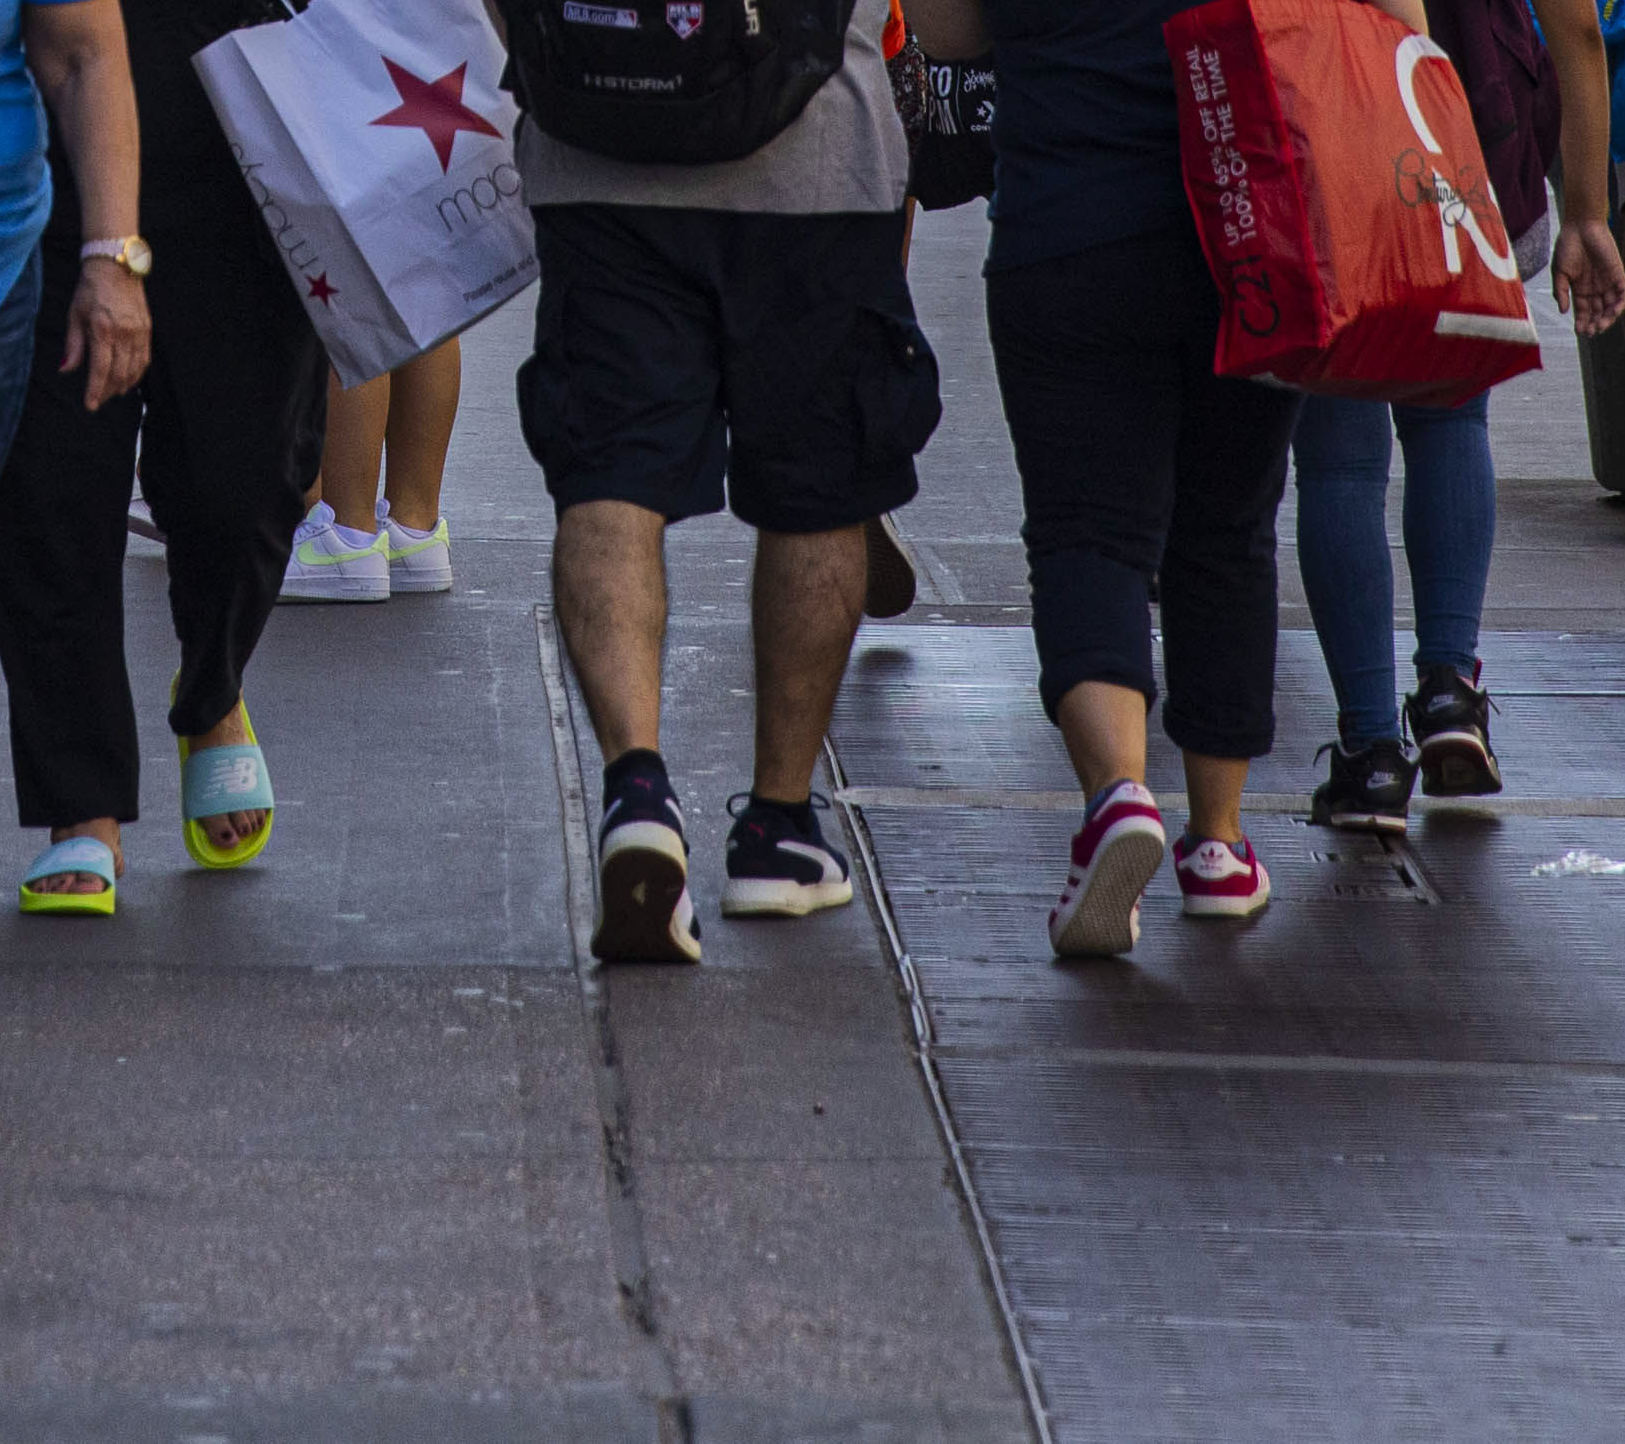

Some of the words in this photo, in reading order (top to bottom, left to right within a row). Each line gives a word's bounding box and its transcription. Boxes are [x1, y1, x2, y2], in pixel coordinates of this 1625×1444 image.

[1186, 45, 1210, 103] RETAIL
[1203, 50, 1228, 101] TIME
[1199, 107, 1218, 142] OFF
[1216, 103, 1236, 144] THE
[1234, 180, 1257, 241] 100%
[1224, 222, 1240, 247] UP
